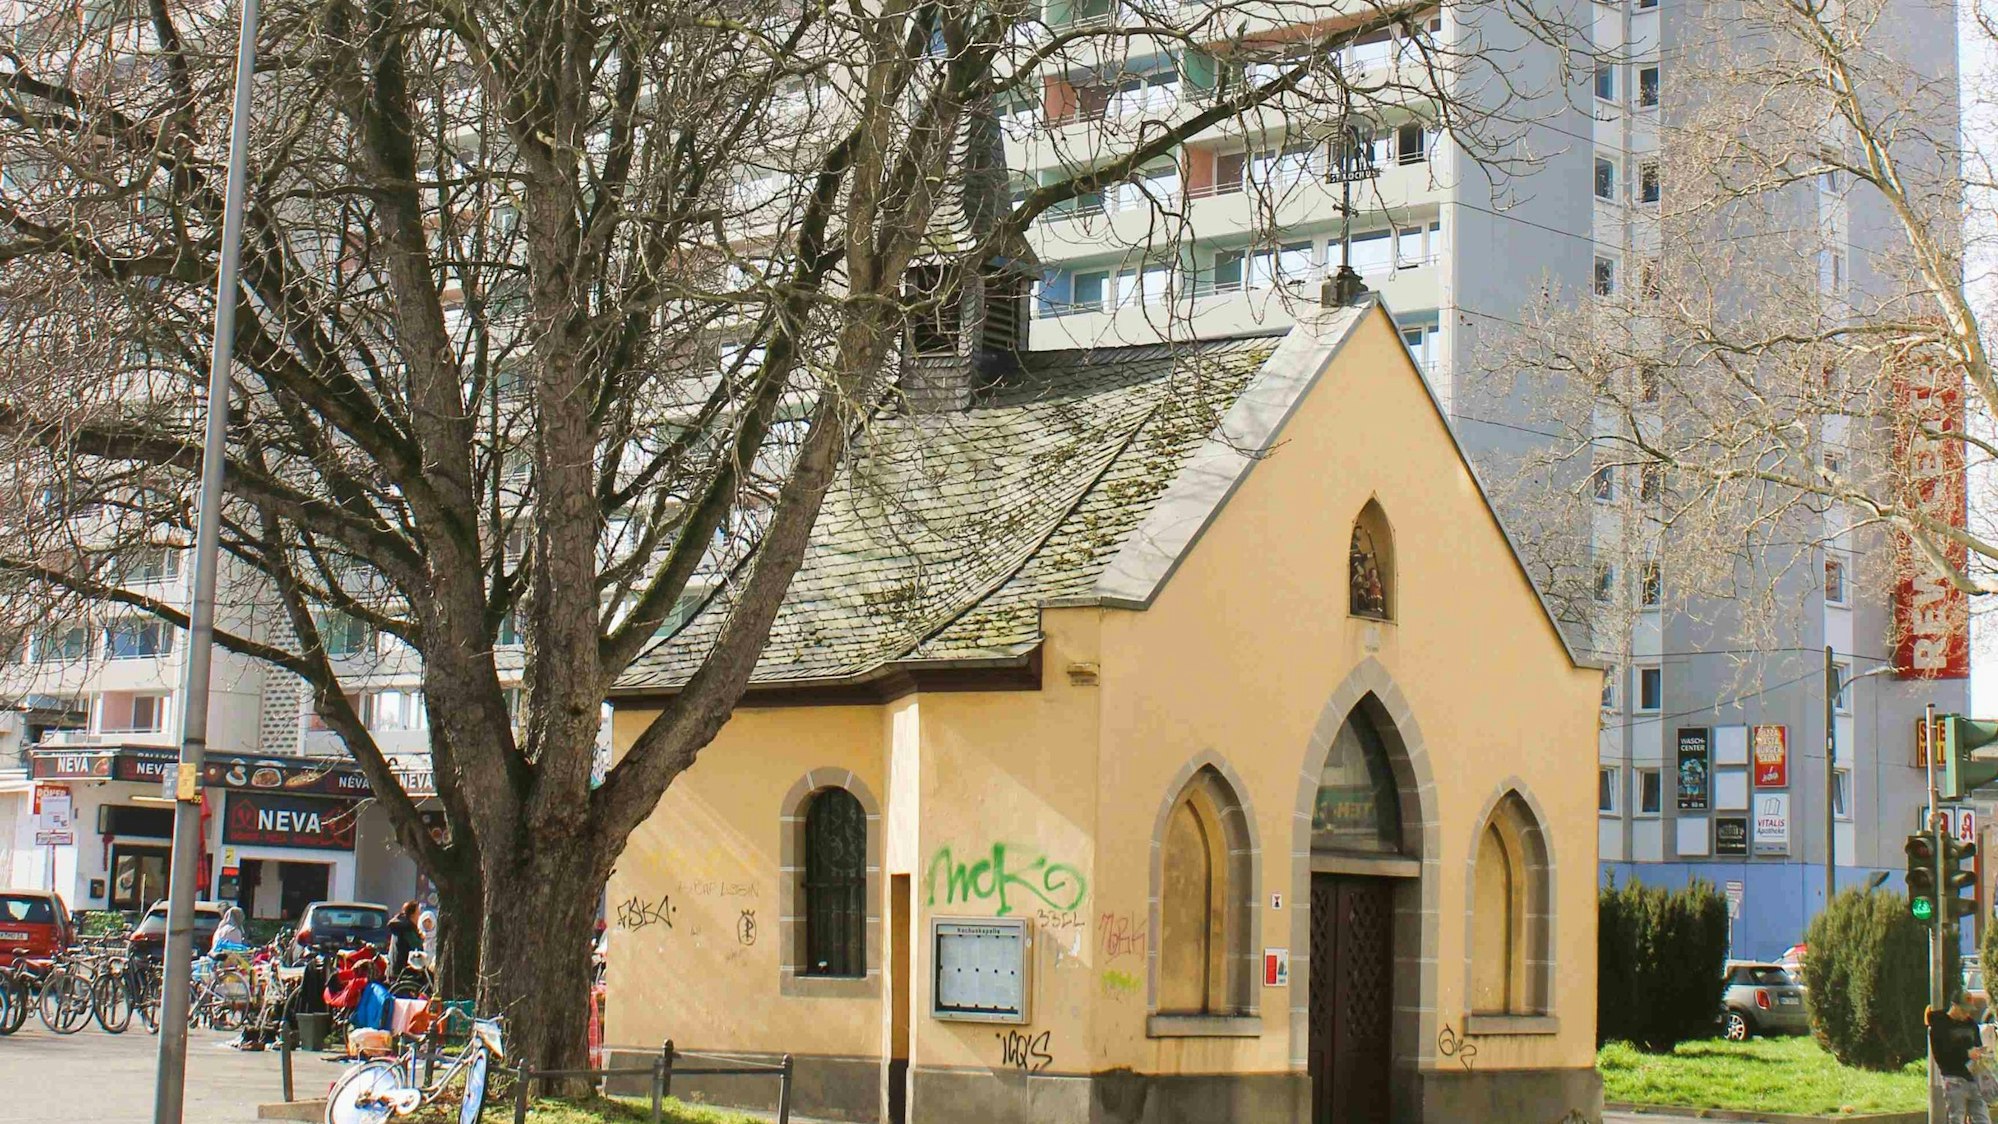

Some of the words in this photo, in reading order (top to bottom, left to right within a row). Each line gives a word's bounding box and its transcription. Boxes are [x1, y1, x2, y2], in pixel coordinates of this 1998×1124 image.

[57, 757, 89, 773] NEVA
[136, 762, 166, 775] NEV
[338, 776, 370, 789] NEVA
[399, 773, 433, 789] NEVA
[258, 809, 321, 833] NEVA
[1758, 819, 1785, 827] VITALIS
